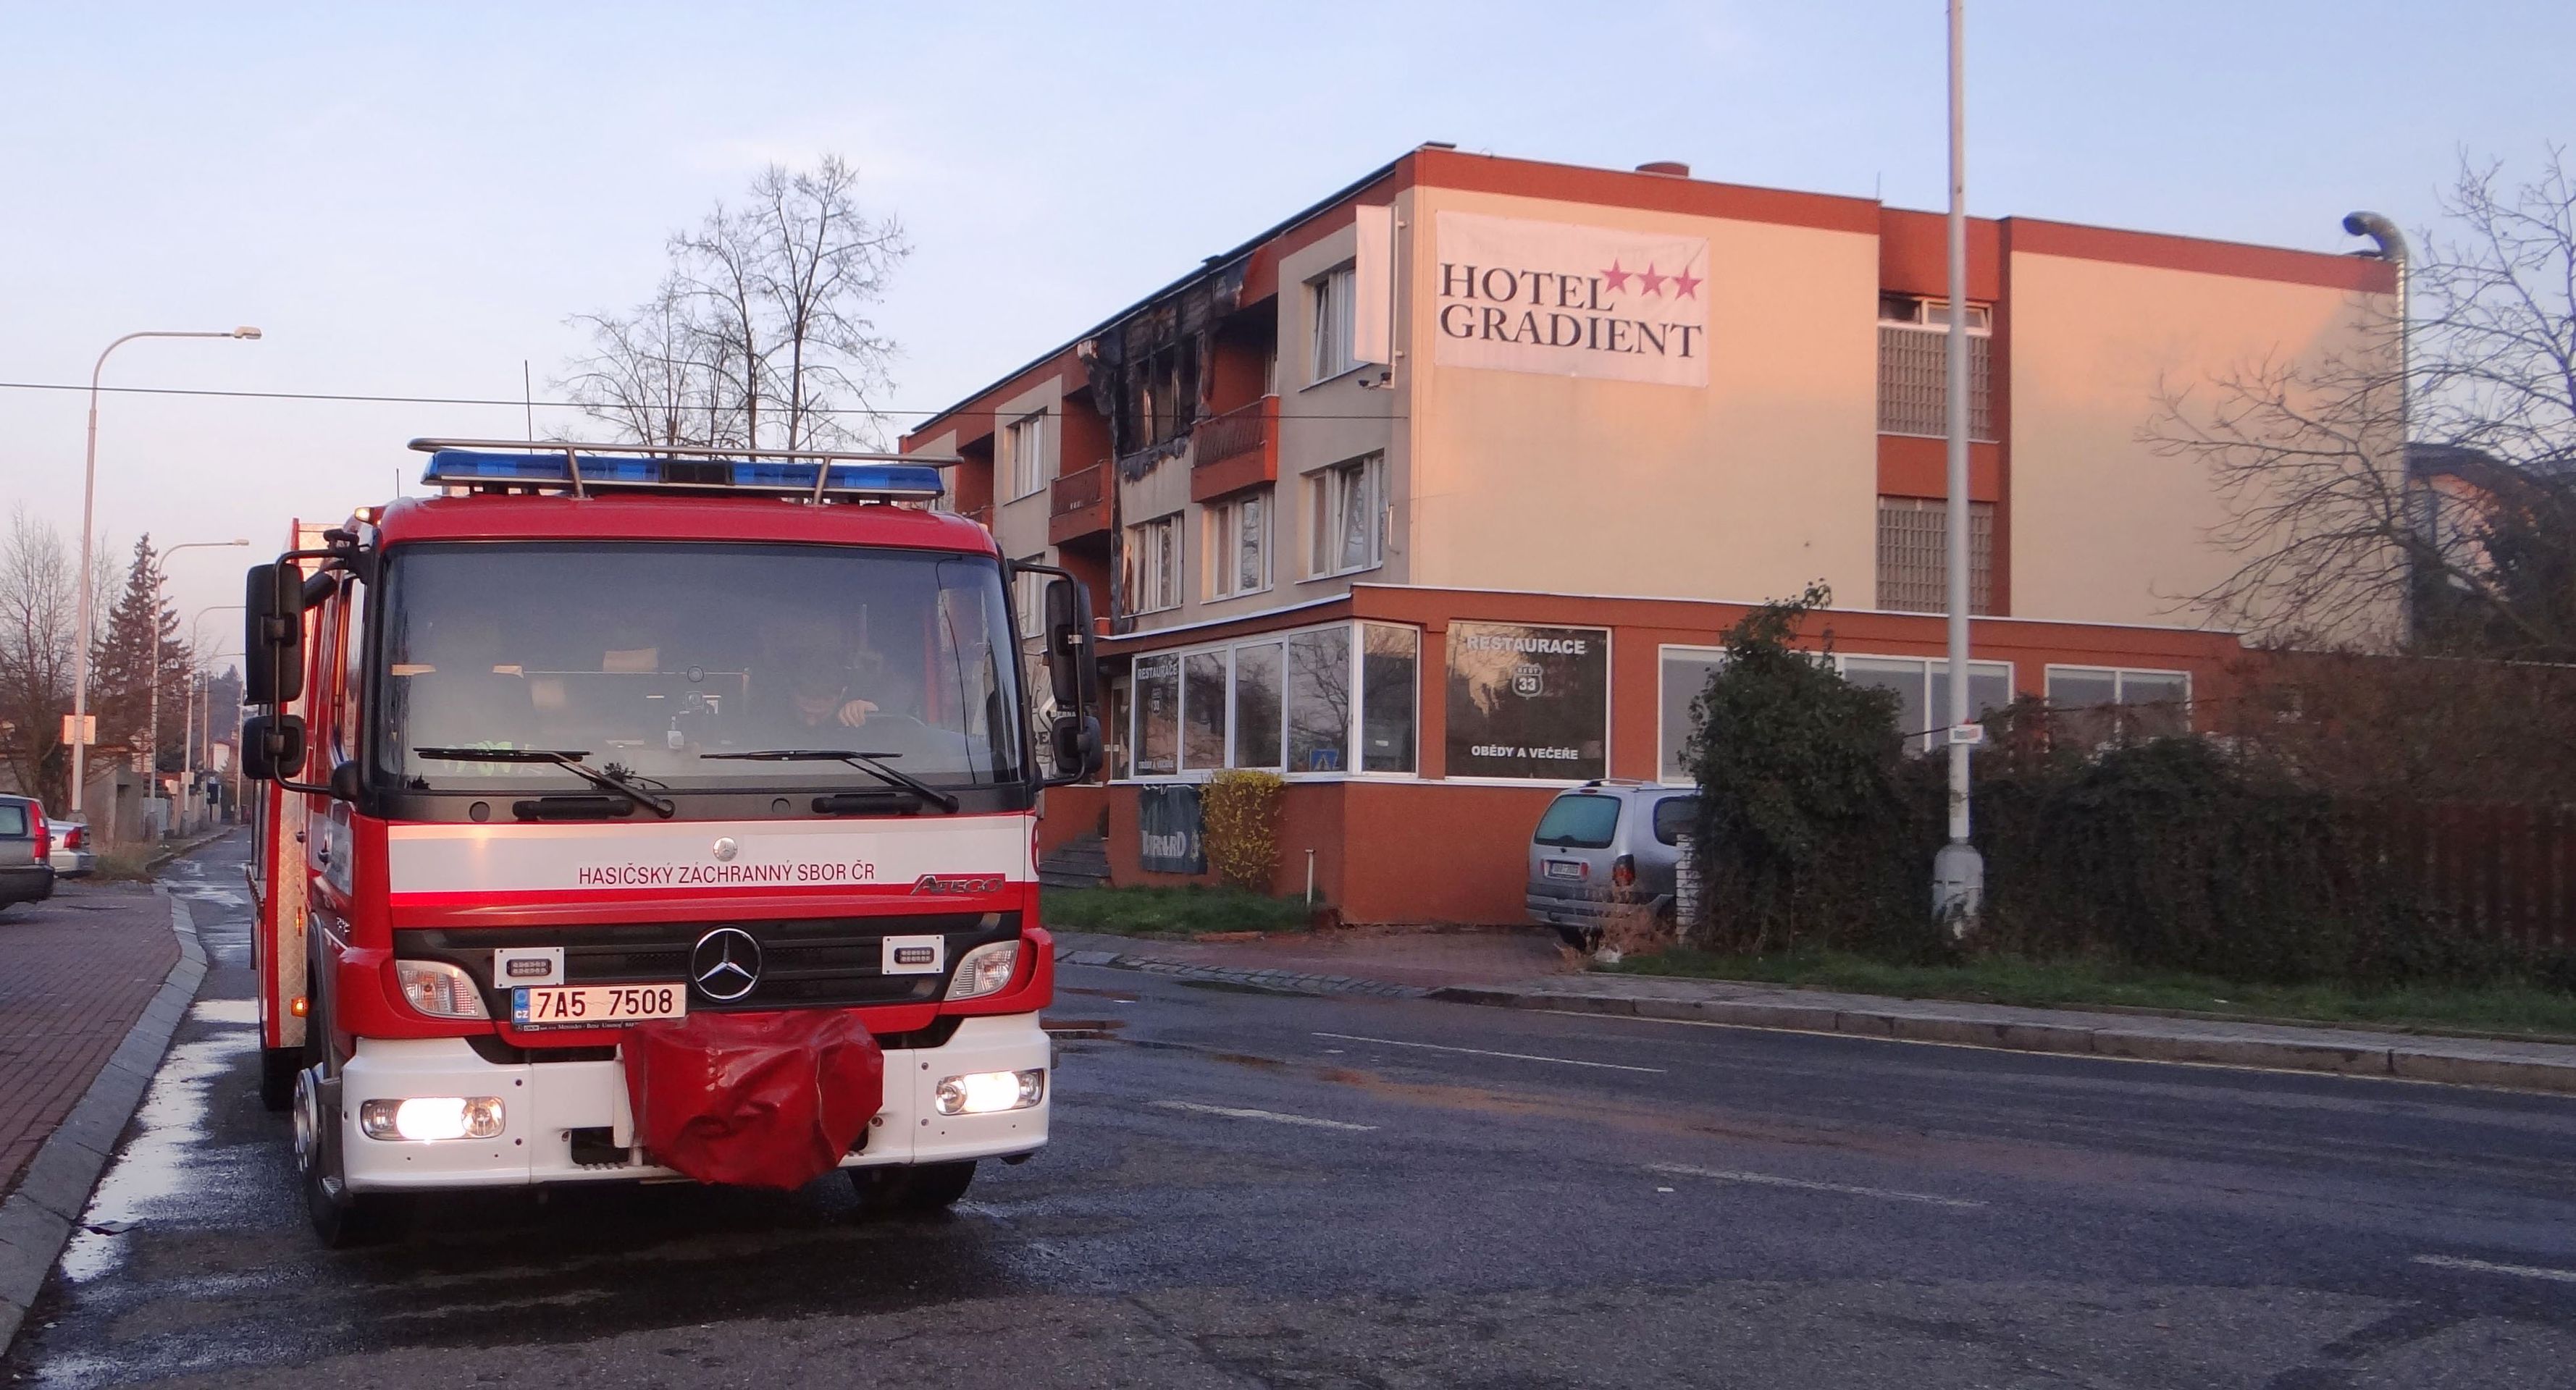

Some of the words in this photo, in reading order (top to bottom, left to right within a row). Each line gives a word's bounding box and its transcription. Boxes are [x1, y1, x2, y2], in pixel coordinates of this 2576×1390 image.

[1440, 262, 1614, 312] HOTEL
[1440, 303, 1702, 358] GRADIENT
[1467, 636, 1587, 654] RESTAURACE
[1519, 678, 1536, 691] 33
[1472, 744, 1514, 757] OBĚDY
[1516, 748, 1527, 758] A
[1529, 746, 1579, 760] VEČEŘE
[579, 862, 674, 885] HASIČSKÝ
[679, 860, 792, 883] ZÁCHRANNÝ
[797, 864, 847, 881] SBOR
[852, 859, 875, 880] ČR
[516, 1010, 529, 1019] CZ
[537, 991, 586, 1018] 7A5
[609, 988, 673, 1016] 7508
